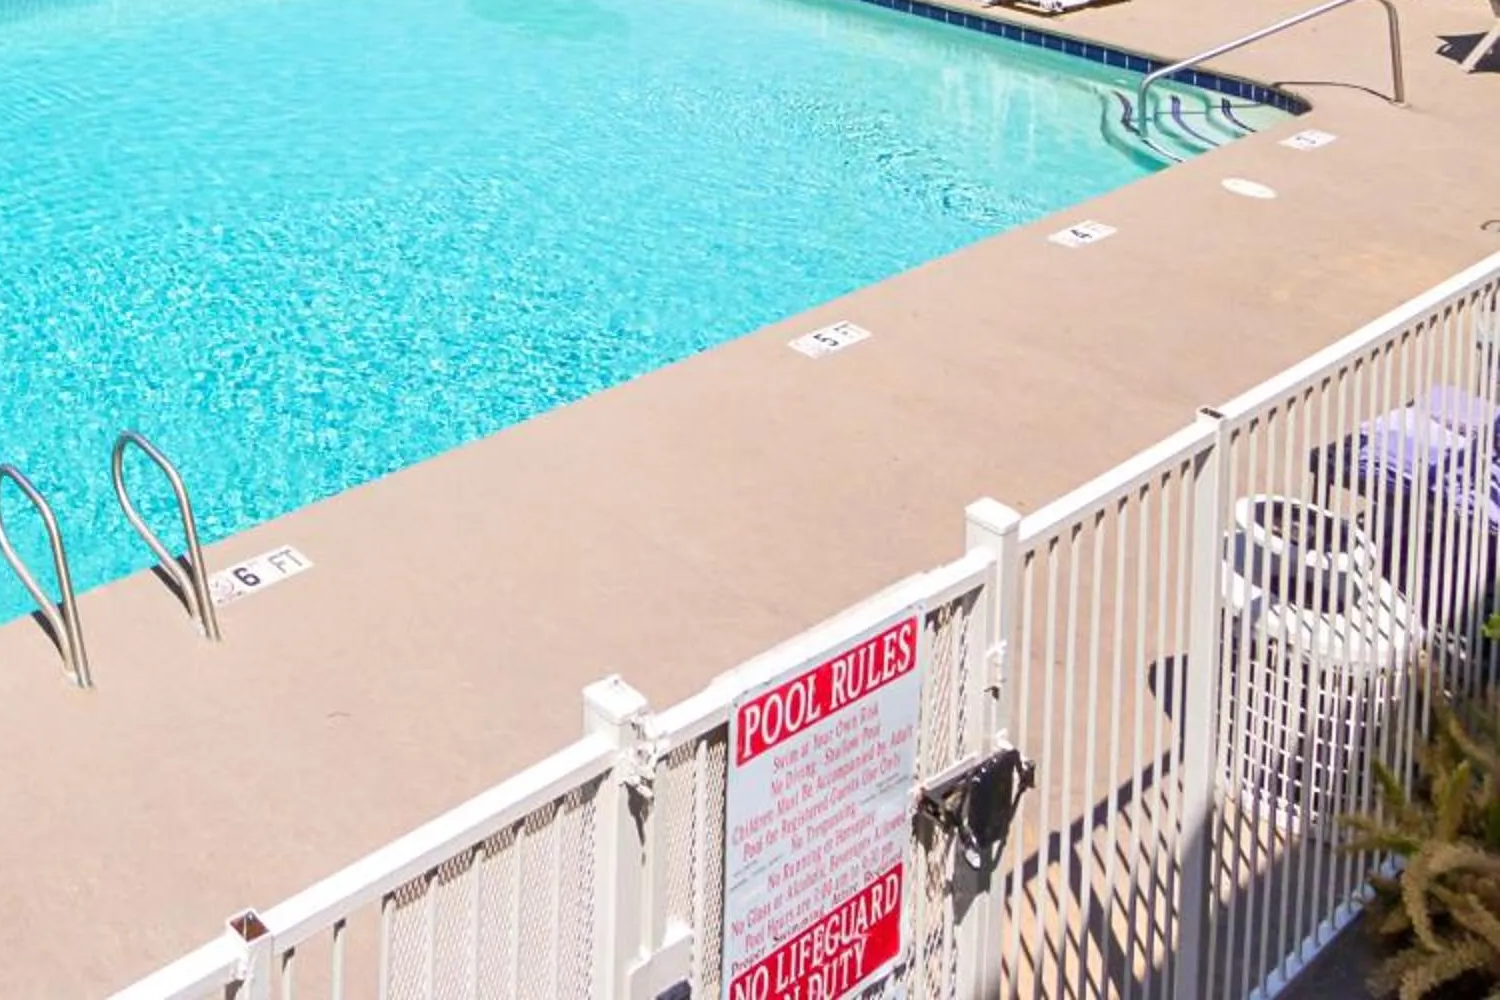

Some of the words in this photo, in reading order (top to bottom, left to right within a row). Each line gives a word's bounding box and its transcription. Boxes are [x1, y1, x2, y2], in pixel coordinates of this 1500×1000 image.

[812, 332, 839, 347] 5
[233, 566, 261, 587] 6
[267, 549, 303, 574] FT
[743, 674, 821, 758] POOL
[829, 623, 912, 711] RULES
[773, 748, 798, 773] Swim
[801, 741, 808, 757] at
[813, 728, 833, 751] Your
[836, 715, 857, 738] Own
[859, 699, 878, 724] Risk
[733, 809, 772, 845] Children
[777, 789, 798, 815] Must
[817, 744, 873, 790] Accompanied
[771, 780, 782, 796] No
[785, 760, 814, 787] Diving
[743, 833, 761, 861] Pool
[781, 793, 827, 835] Registered
[830, 776, 859, 805] Guests
[768, 873, 779, 890] No
[783, 845, 821, 880] Running
[732, 919, 743, 938] No
[735, 965, 769, 1000] NO
[775, 873, 899, 993] LIFEGUARD
[746, 925, 763, 951] Pool
[768, 909, 791, 936] Hours
[731, 946, 764, 974] Proper
[808, 935, 868, 1000] DUTY
